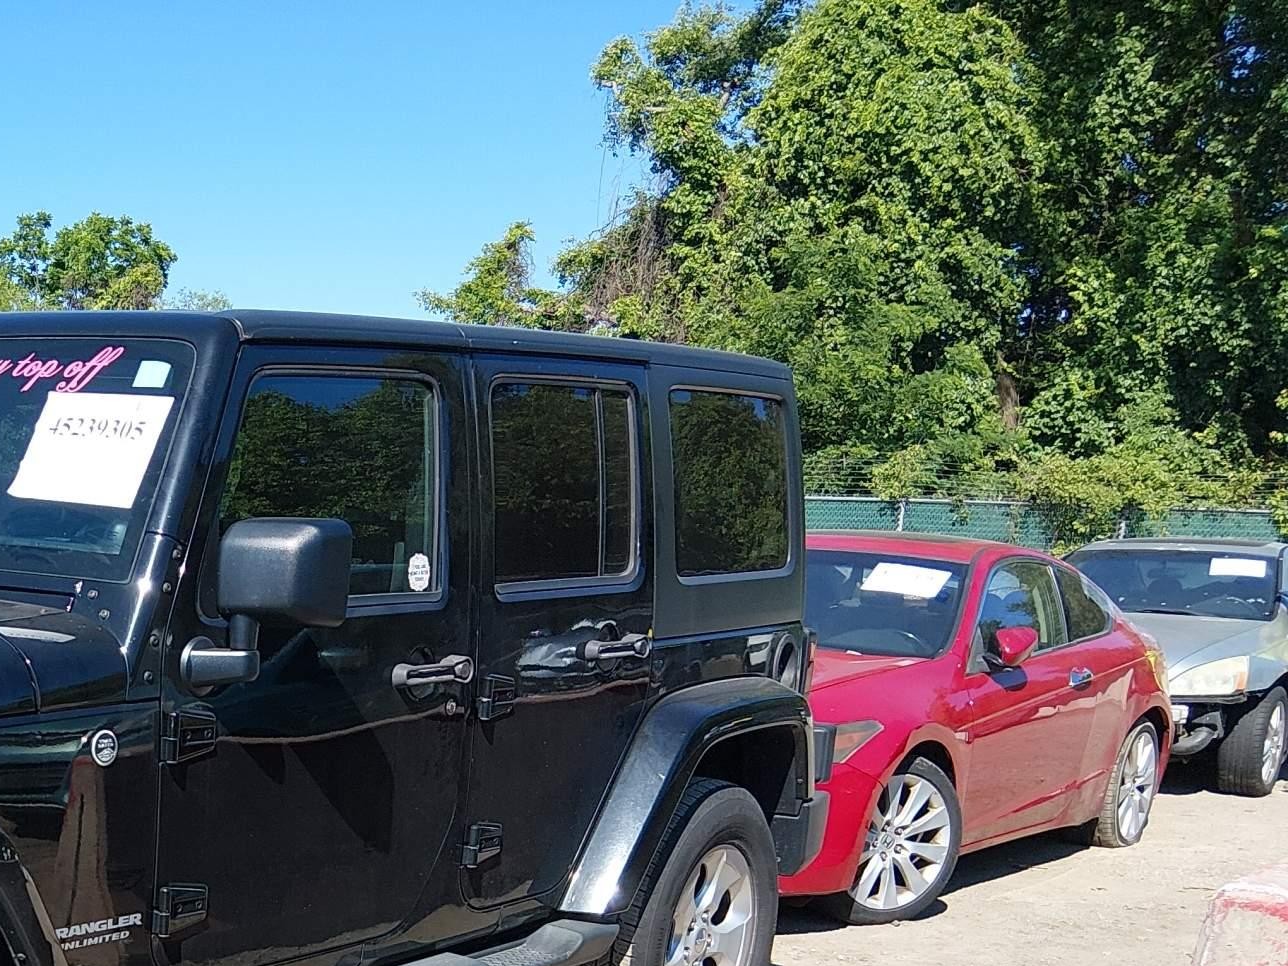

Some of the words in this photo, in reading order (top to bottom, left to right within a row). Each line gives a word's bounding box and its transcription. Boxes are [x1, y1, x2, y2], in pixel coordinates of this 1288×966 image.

[11, 353, 63, 392] top
[56, 346, 126, 393] off
[48, 416, 146, 441] 45239305
[55, 912, 143, 939] RANGLER
